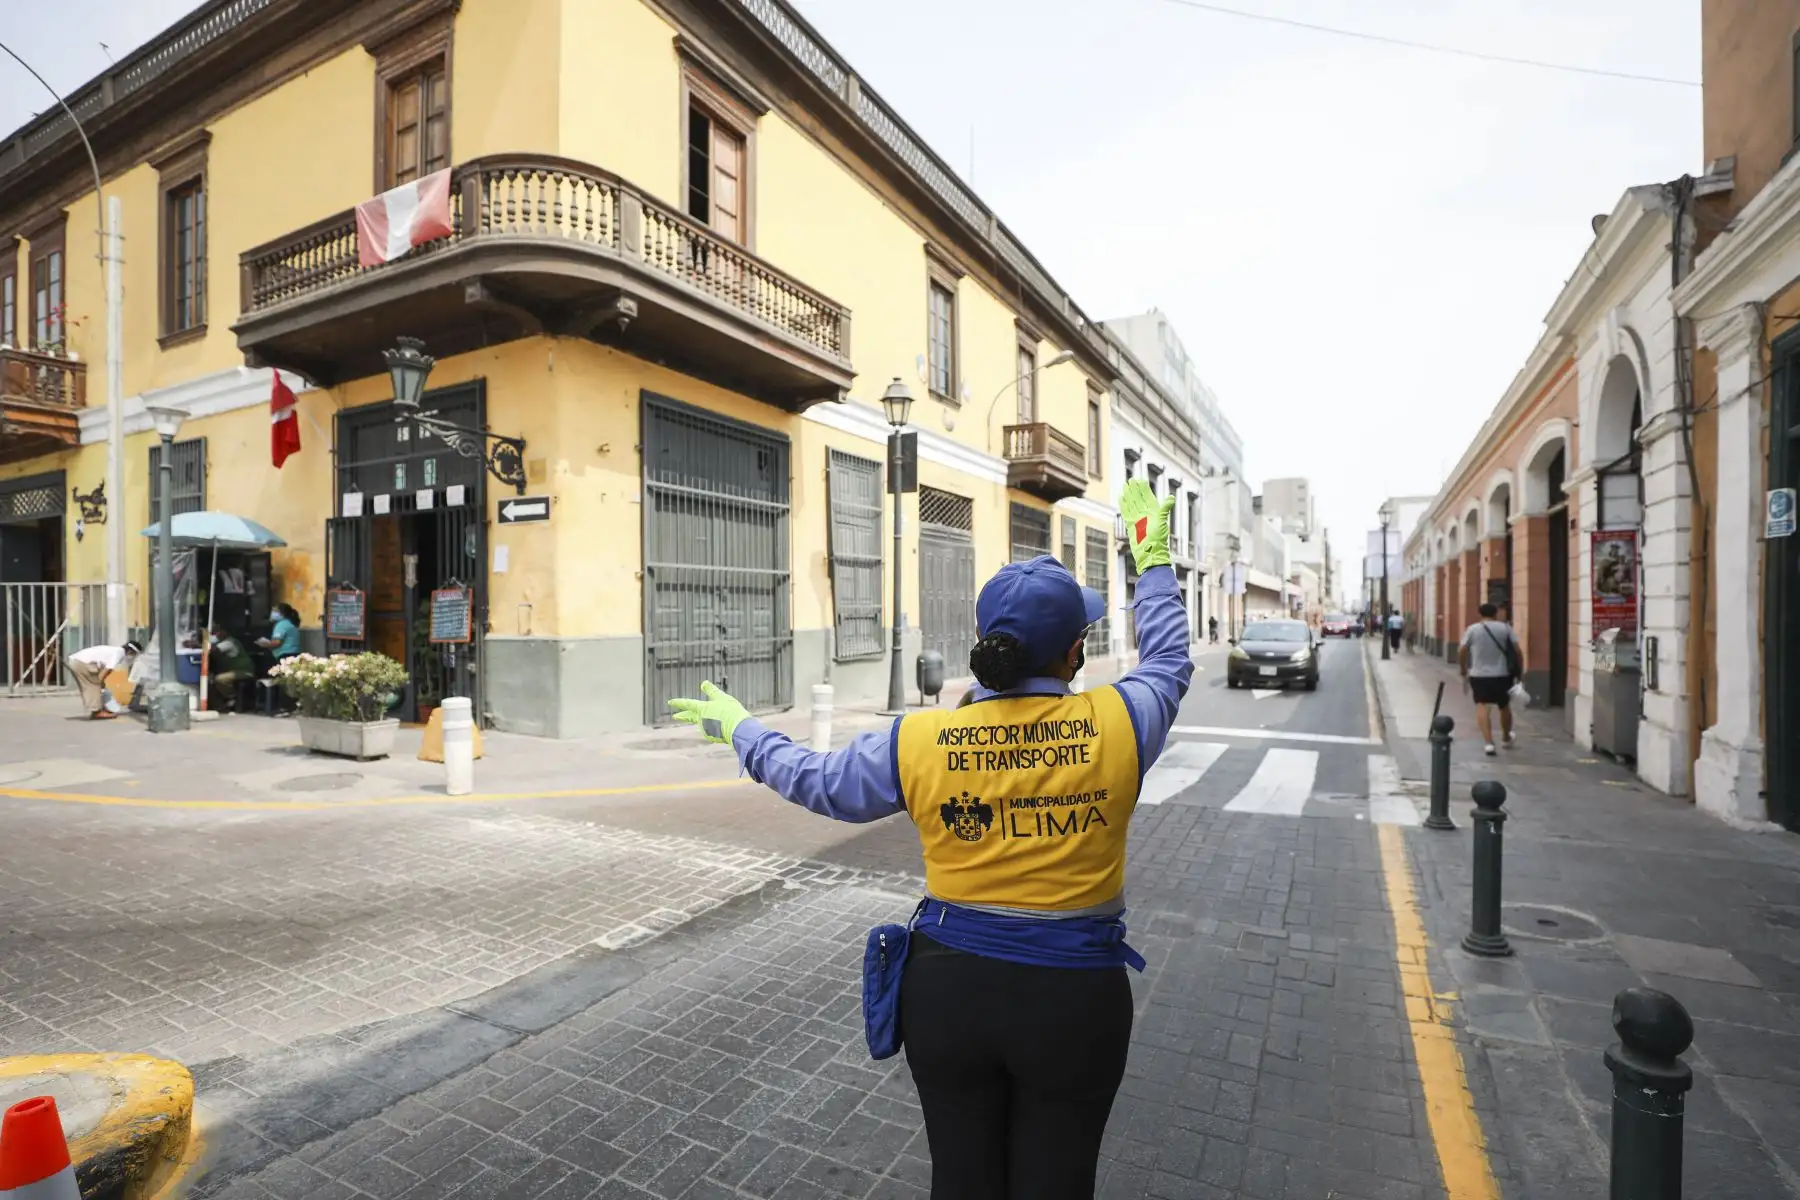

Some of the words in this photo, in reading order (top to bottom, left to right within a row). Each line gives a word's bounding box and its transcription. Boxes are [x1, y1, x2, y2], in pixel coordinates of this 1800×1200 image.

[937, 725, 1020, 746] INSPECTOR
[1023, 718, 1099, 745] MUNICIPAL
[948, 751, 970, 771] DE
[972, 744, 1091, 771] TRANSPORTE
[1010, 792, 1091, 809] MUNICIPALIDAD
[1094, 789, 1108, 801] DE
[1010, 806, 1108, 837] LIMA
